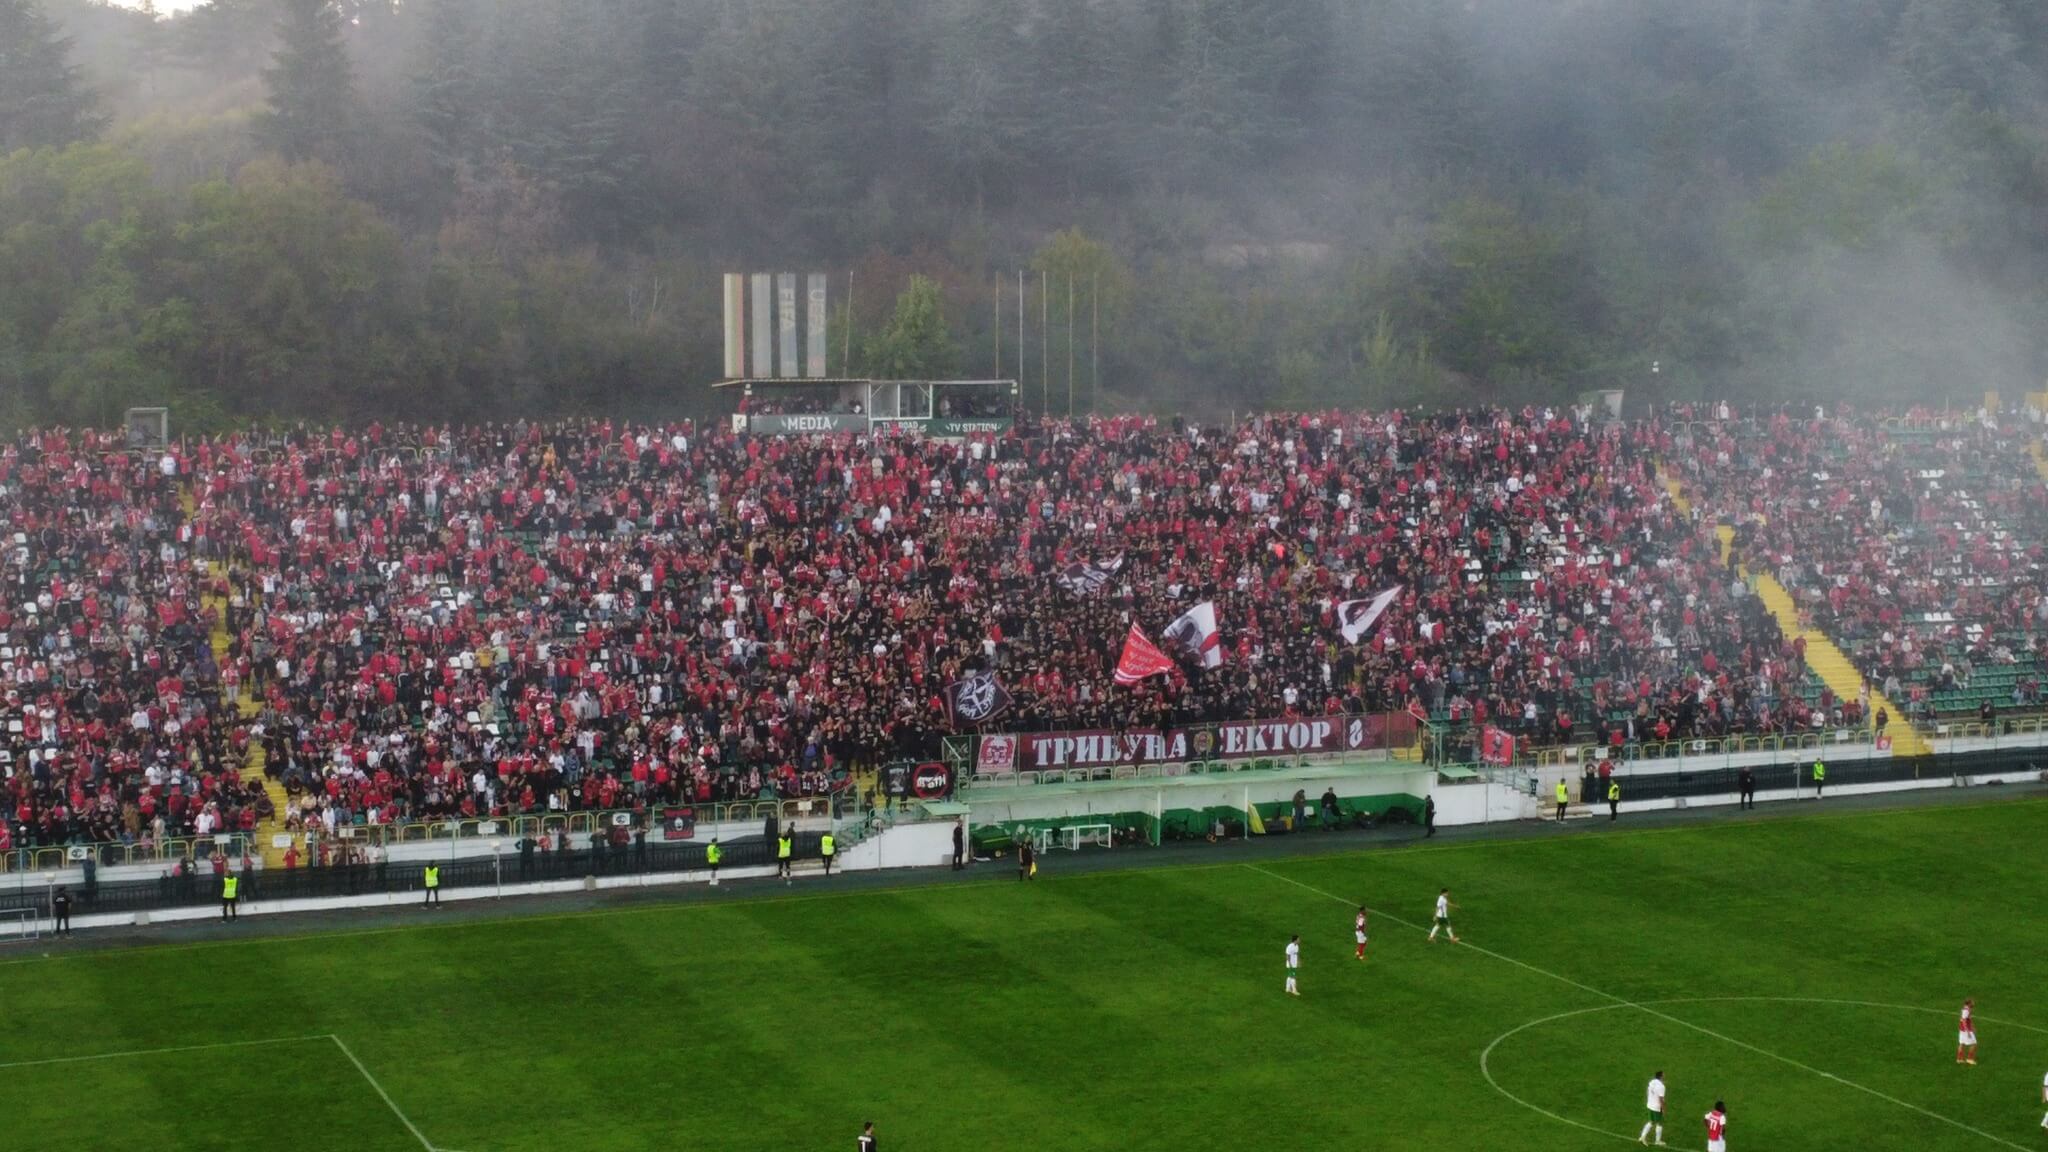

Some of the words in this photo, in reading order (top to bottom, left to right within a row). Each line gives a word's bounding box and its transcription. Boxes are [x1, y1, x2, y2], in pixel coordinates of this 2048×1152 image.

[787, 416, 832, 431] MEDIA
[949, 422, 961, 432] TV
[963, 422, 998, 433] STATION
[1032, 732, 1187, 767] ТРИБУНА
